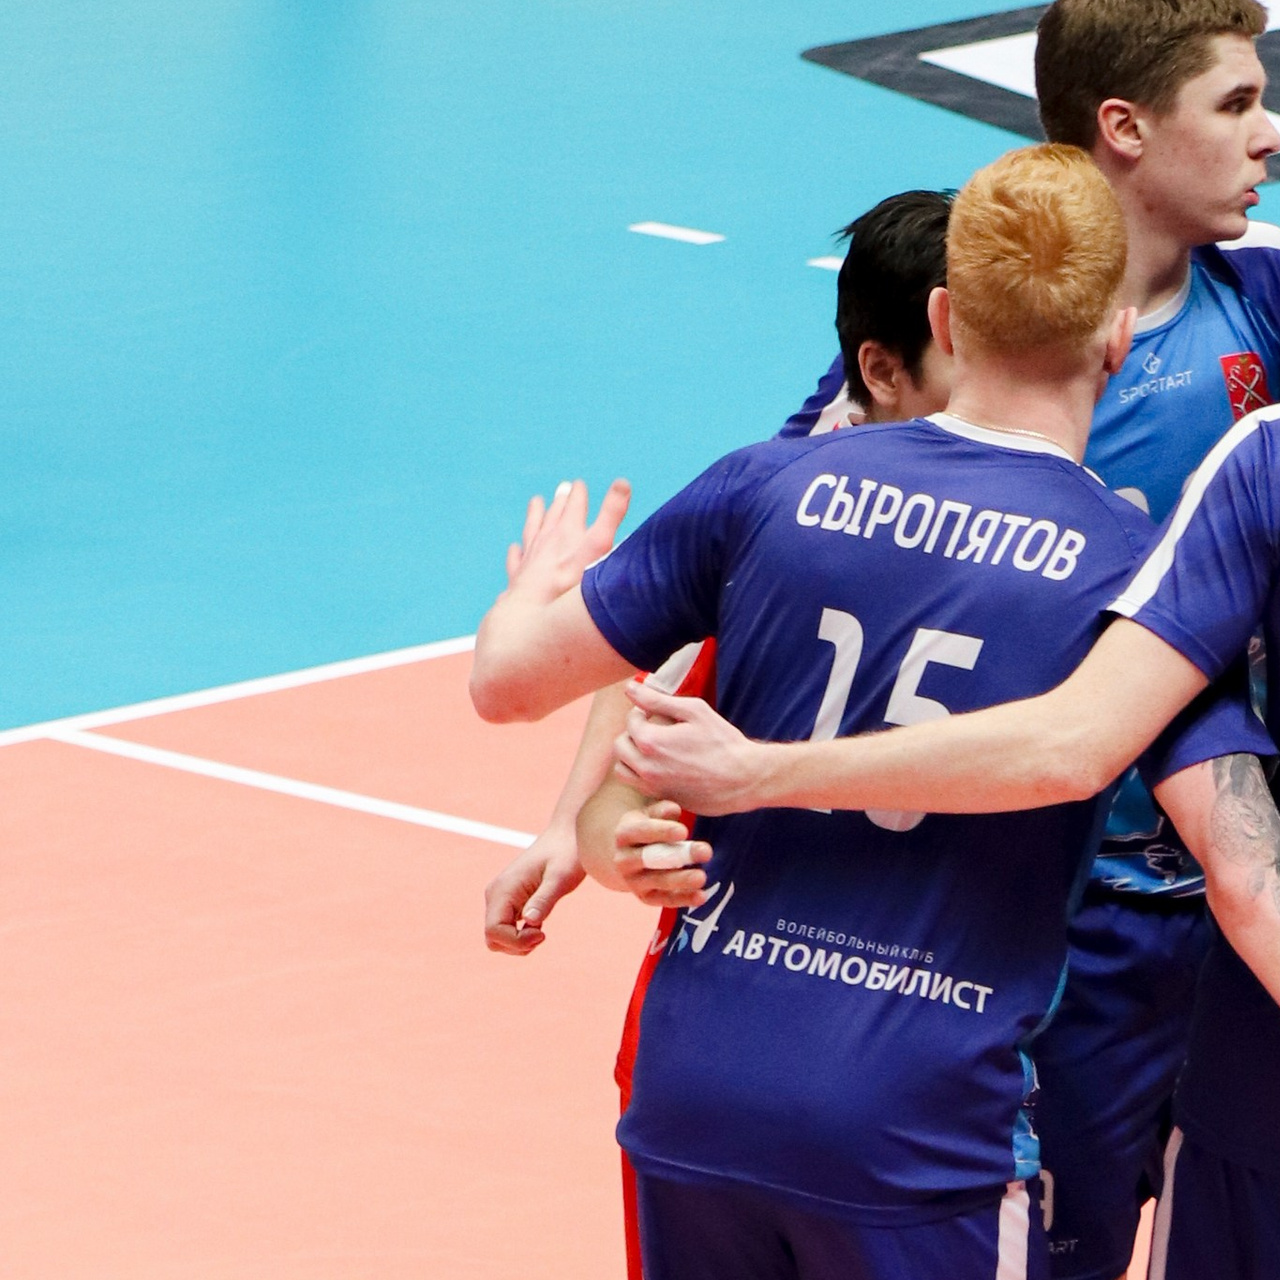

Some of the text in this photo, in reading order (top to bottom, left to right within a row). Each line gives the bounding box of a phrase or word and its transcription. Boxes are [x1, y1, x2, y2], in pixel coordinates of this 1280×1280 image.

[1118, 370, 1194, 405] SPORTART
[795, 473, 1087, 581] СЫРОПЯТОВ
[776, 918, 901, 958] ВОЛЕЙБОЛЬНЫЙ
[722, 929, 994, 1014] АВТОМОБИЛИСТ
